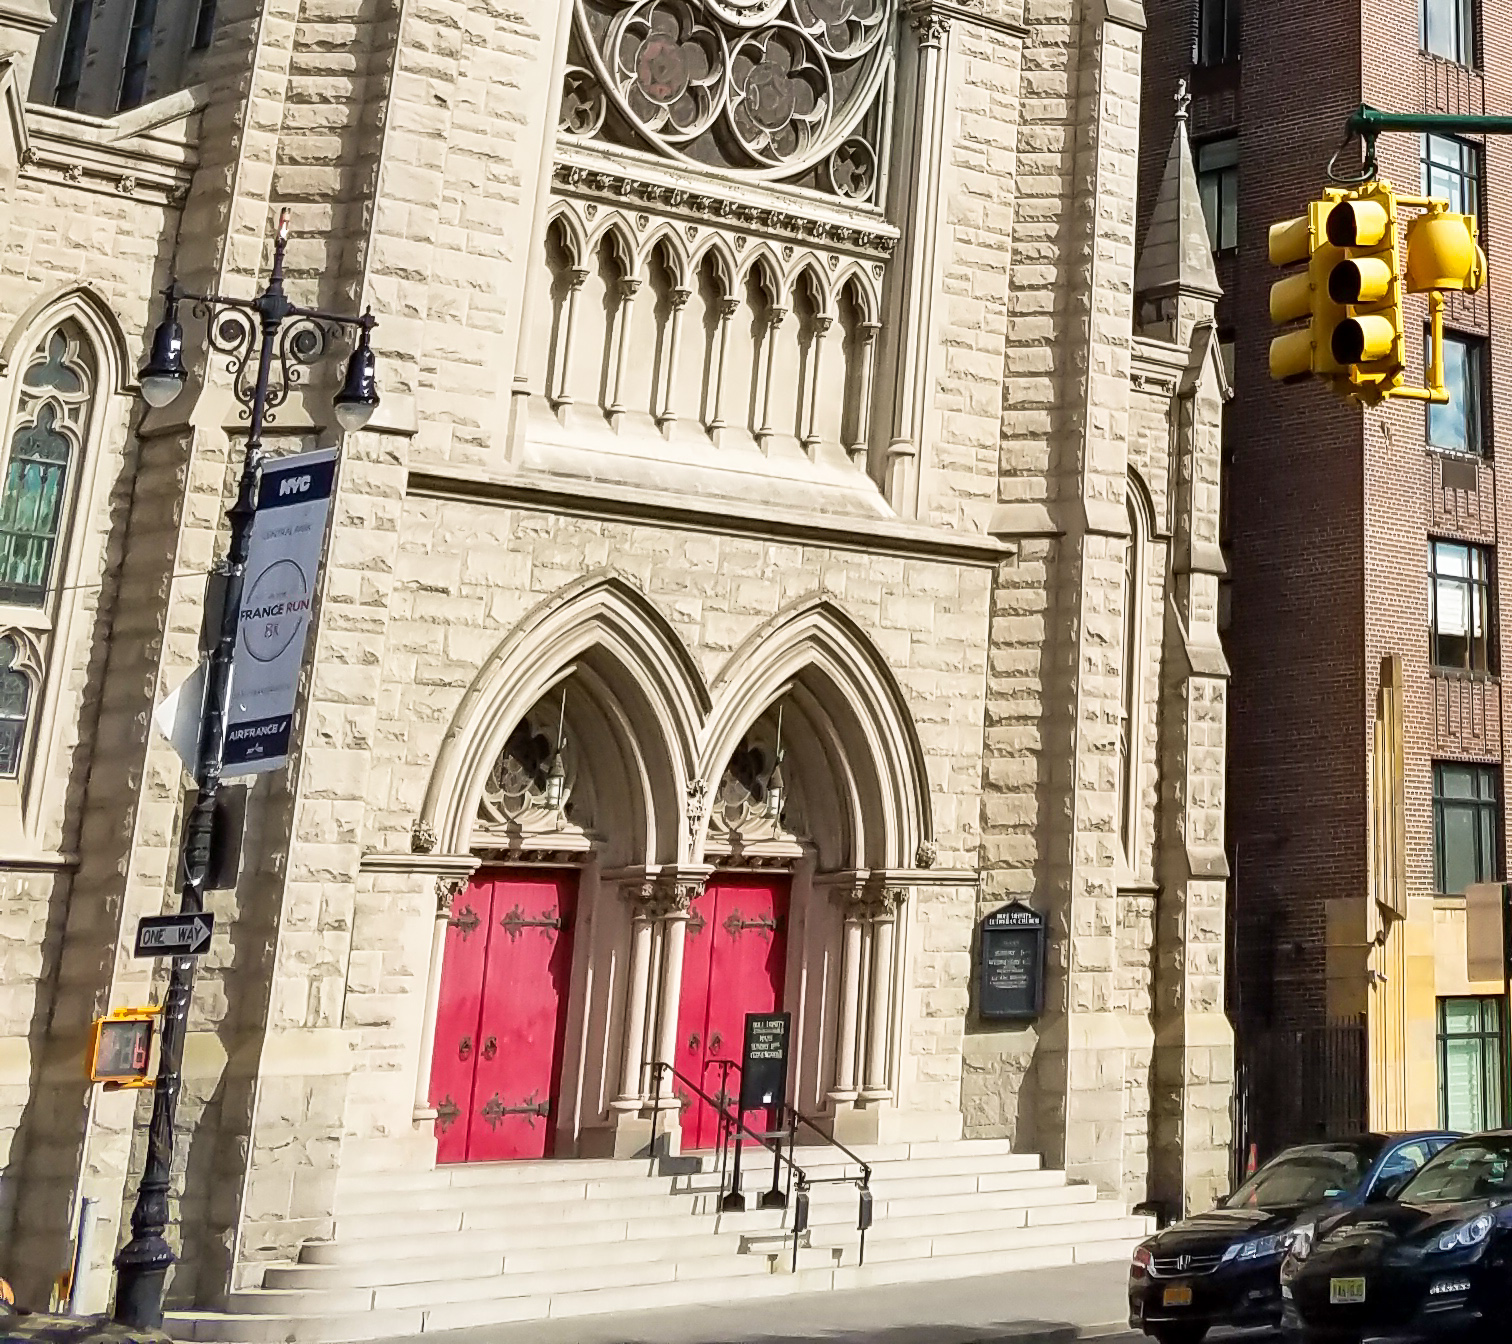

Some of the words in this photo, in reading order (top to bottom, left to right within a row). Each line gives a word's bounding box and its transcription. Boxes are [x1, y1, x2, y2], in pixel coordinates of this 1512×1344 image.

[279, 474, 312, 497] NYC
[240, 603, 284, 622] FRANCE
[285, 598, 310, 614] RUN
[143, 928, 166, 946] ONE
[178, 924, 203, 943] WAY
